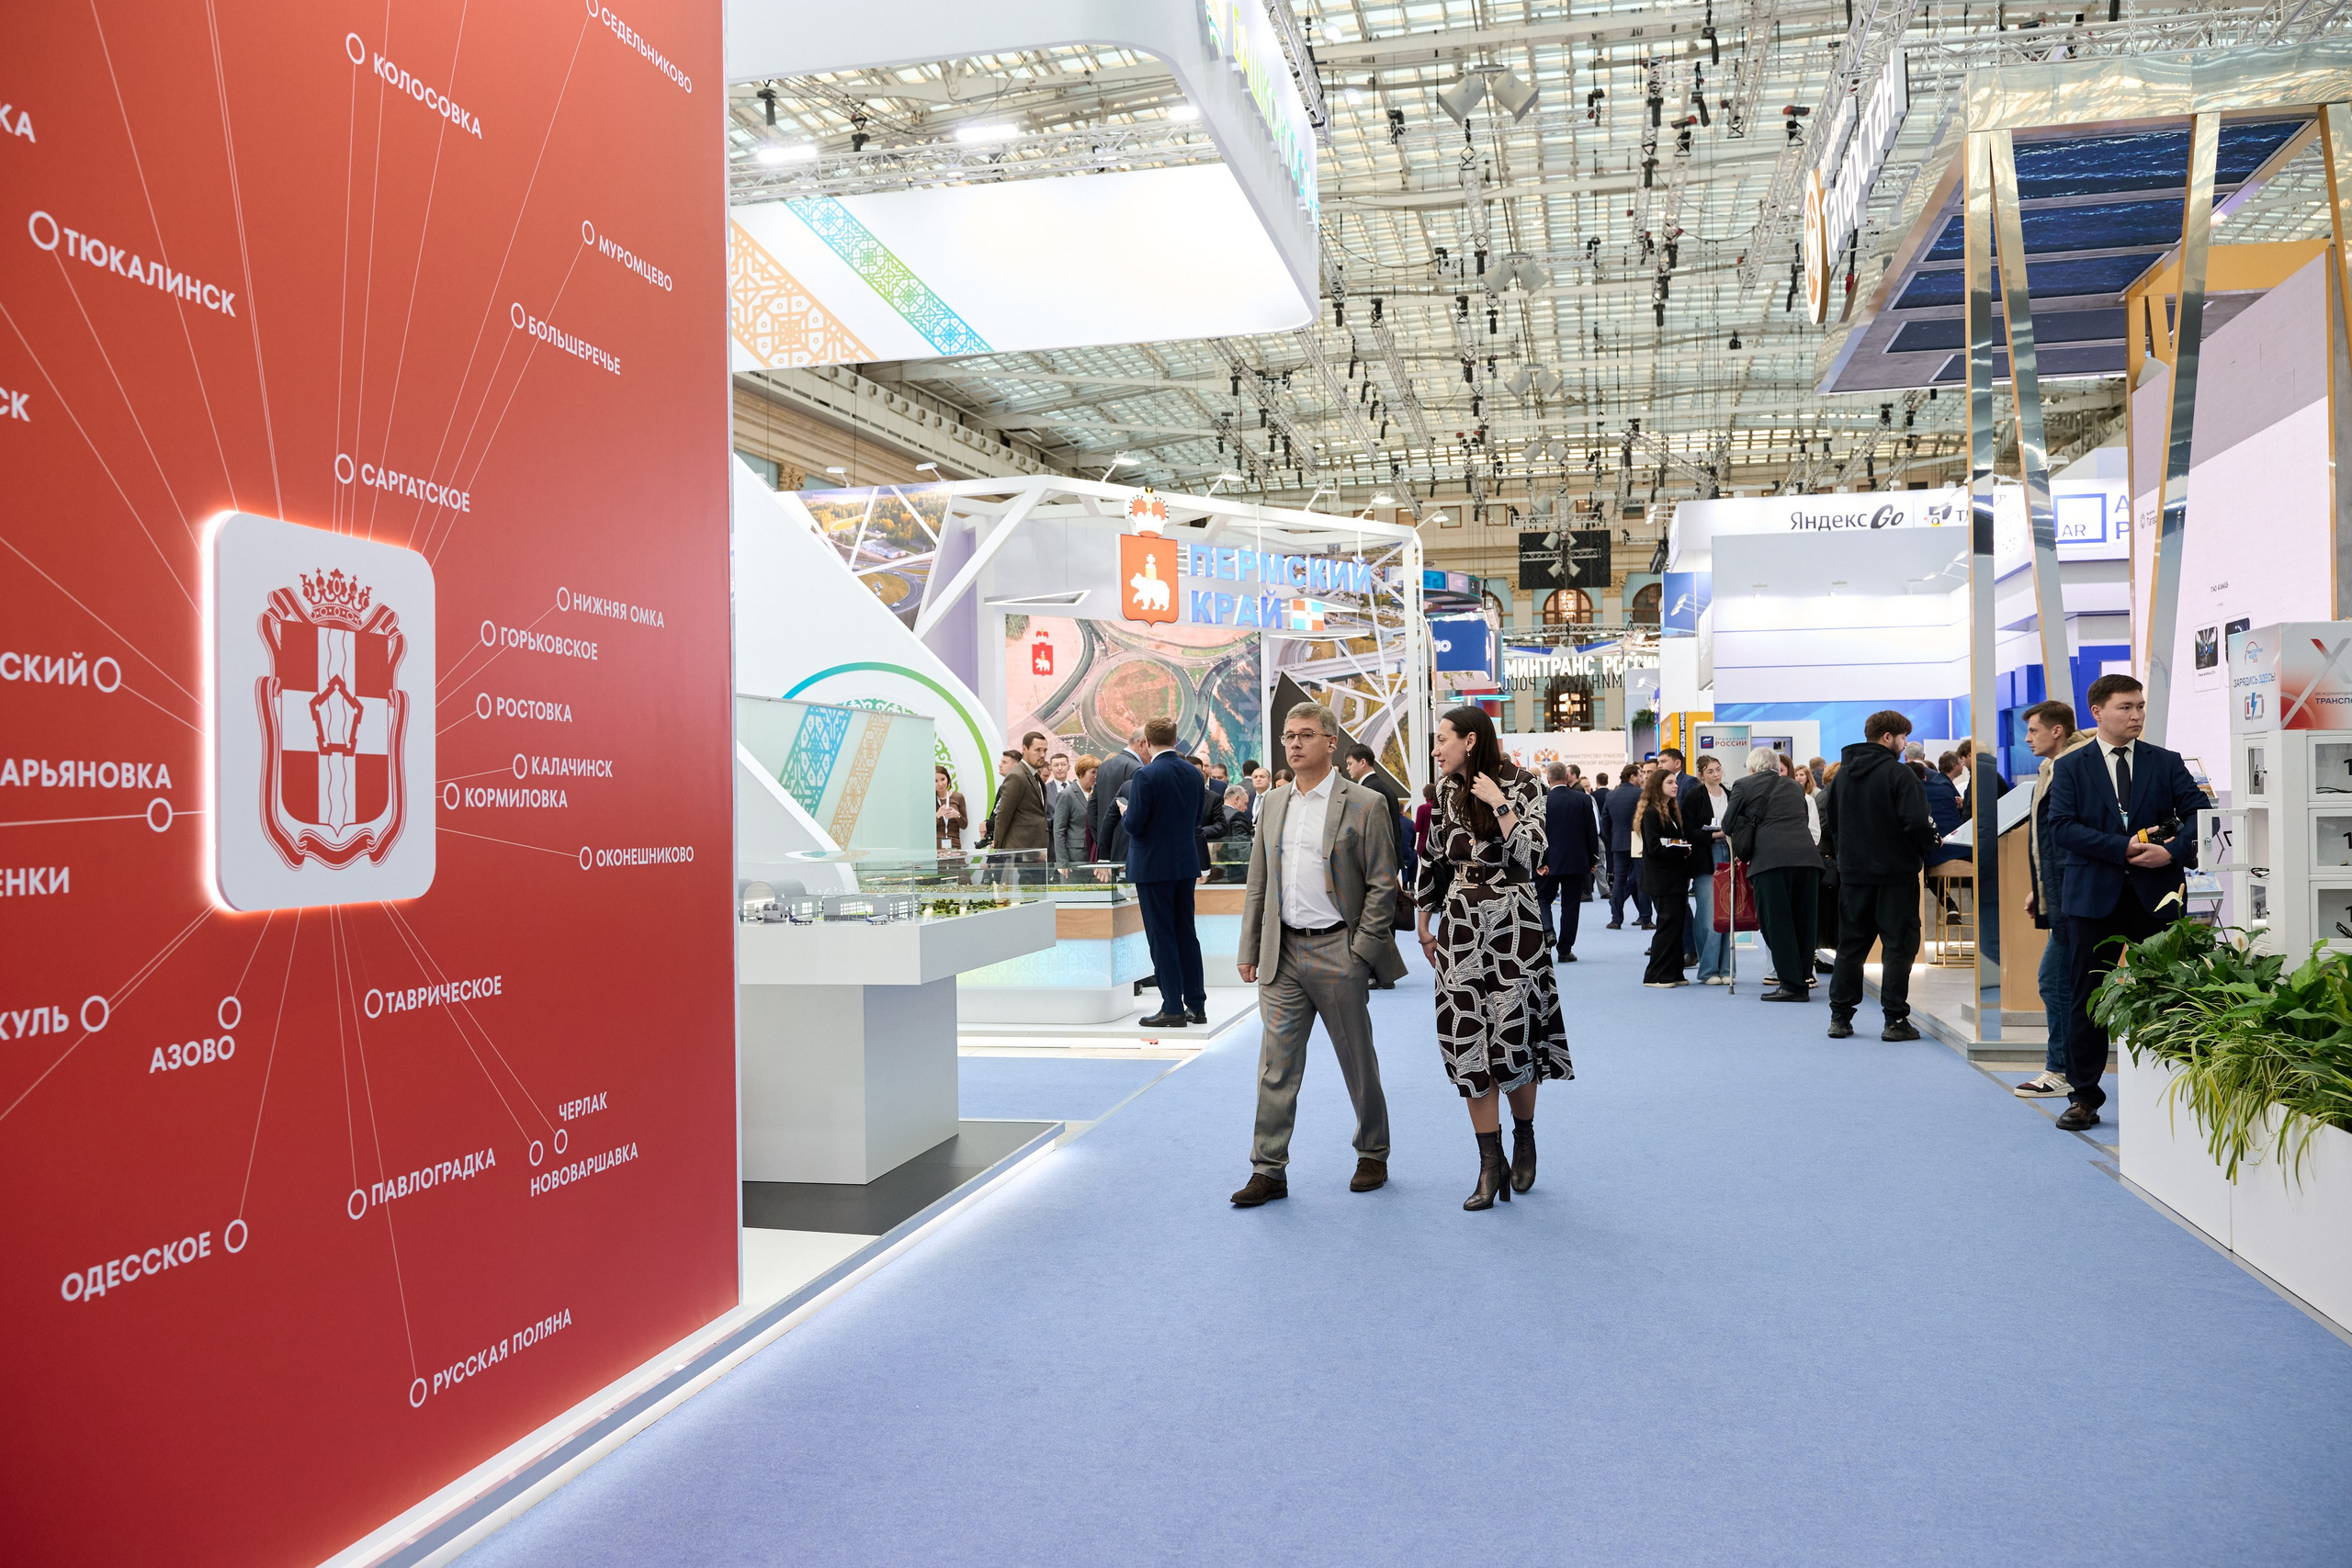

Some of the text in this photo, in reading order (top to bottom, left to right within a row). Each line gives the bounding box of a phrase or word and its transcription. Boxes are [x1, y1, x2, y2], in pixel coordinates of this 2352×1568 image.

[601, 7, 693, 94] СЕДЕЛЬНИКОВО
[374, 52, 482, 140] КОЛОСОВКА
[1821, 48, 1898, 267] Татарстан
[63, 228, 236, 318] ТЮКАЛИНСК
[599, 234, 673, 292] МУРОМЦЕВО
[527, 315, 621, 376] БОЛЬШЕРЕЧЬЕ
[361, 463, 470, 513] САРГАТСКОЕ
[1791, 504, 1905, 531] Яндекс Go
[2062, 524, 2086, 536] AR
[1187, 544, 1372, 594] ПЕРМСКИЙ
[573, 592, 665, 628] НИЖНЯЯ ОМКА
[1191, 590, 1283, 629] КРАЙ
[500, 626, 599, 661] ГОРЬКОВСКОЕ
[0, 651, 88, 687] СКИЙ
[1504, 656, 1595, 678] МИНТРАНС
[2233, 672, 2276, 688] ЗАРЯДИСЬ ЗДЕСЬ!
[497, 696, 573, 723] РОСТОВКА
[0, 759, 173, 789] АРЬЯНОВКА
[531, 755, 614, 778] КАЛАЧИНСК
[465, 787, 569, 810] КОРМИЛОВКА
[596, 845, 695, 868] ОКОНЕШНИКОВО
[2256, 902, 2262, 919] 8
[385, 975, 503, 1014] ТАВРИЧЕСКОЕ
[149, 1034, 235, 1074] АЗОВО
[559, 1090, 608, 1122] ЧЕРЛАК
[371, 1147, 496, 1207] ПАВЛОГРАДКА
[530, 1142, 639, 1198] НОВОВАРШАВКА
[61, 1231, 211, 1303] ОДЕССКОЕ
[433, 1307, 572, 1395] РУССКАЯ ПОЛЯНА
